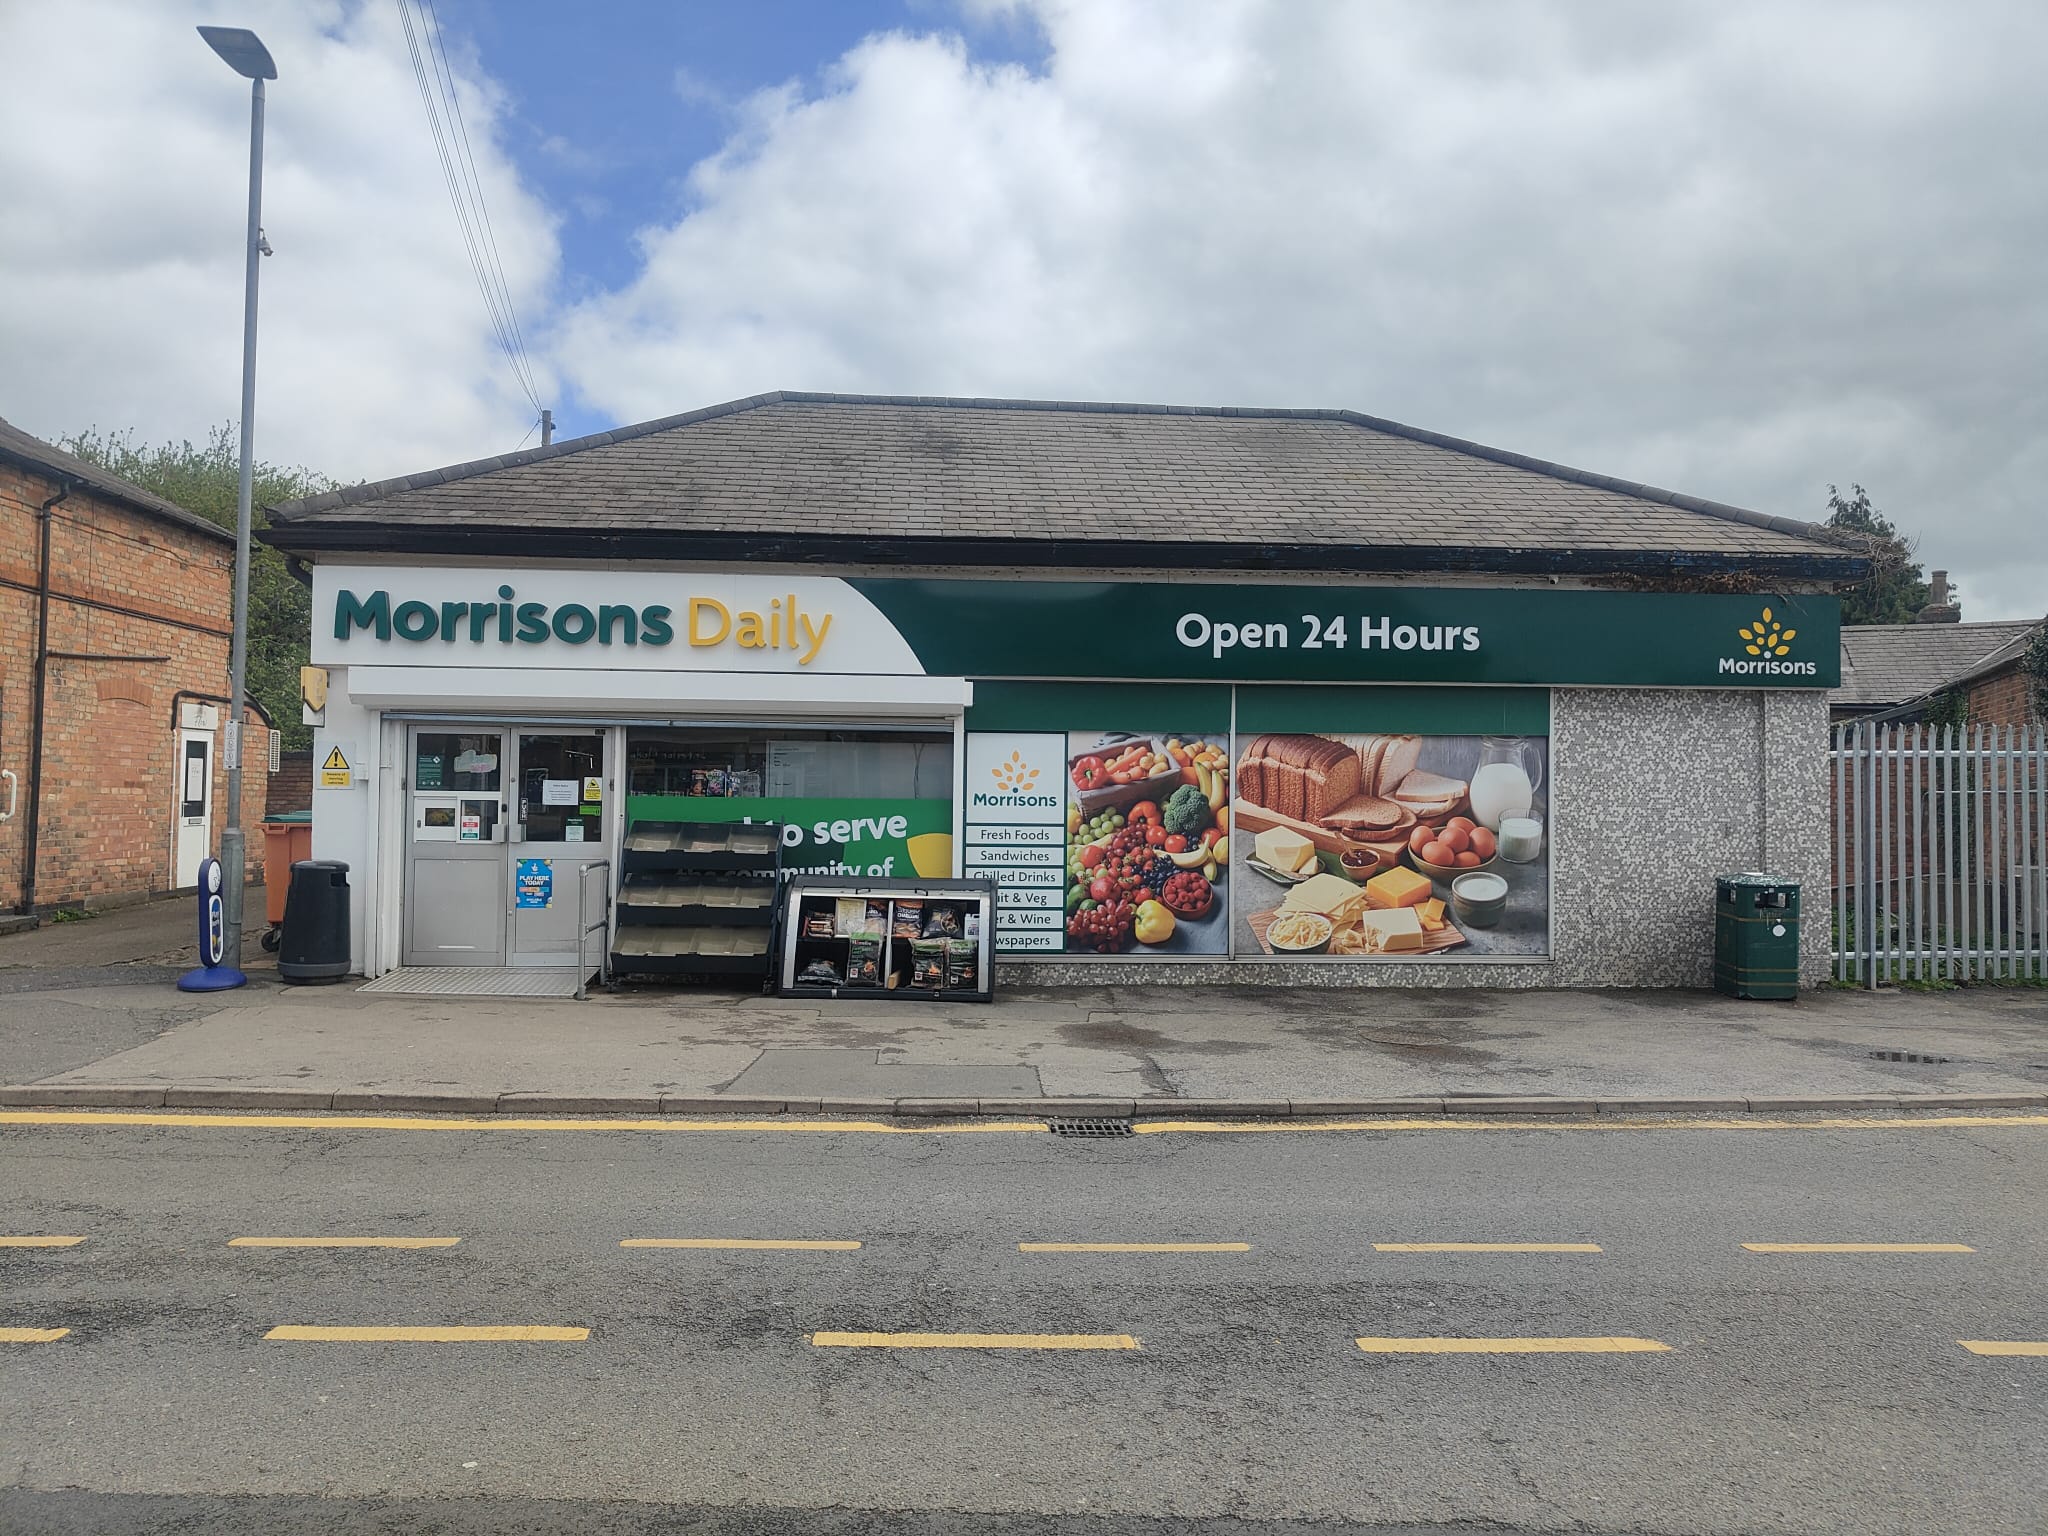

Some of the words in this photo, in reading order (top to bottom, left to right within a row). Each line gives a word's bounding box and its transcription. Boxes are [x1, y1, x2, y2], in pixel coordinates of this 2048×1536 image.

[334, 584, 674, 646] Morrisons
[688, 594, 833, 665] Daily
[1176, 613, 1288, 658] Open
[1301, 615, 1347, 648] 24
[1361, 616, 1480, 651] Hours
[1719, 651, 1816, 675] Morrisons
[973, 787, 1057, 807] Morrisons
[814, 815, 907, 845] serve
[980, 829, 1011, 840] Fresh
[1015, 830, 1049, 840] Foods
[980, 851, 1049, 861] Sandwiches
[867, 857, 894, 877] of
[973, 871, 1015, 882] Chilled
[1018, 871, 1055, 882] Drinks
[1013, 892, 1021, 903] &
[1025, 892, 1047, 906] Veg
[1007, 913, 1016, 924] &
[1020, 913, 1051, 924] Wine
[996, 937, 1050, 948] wspapers
